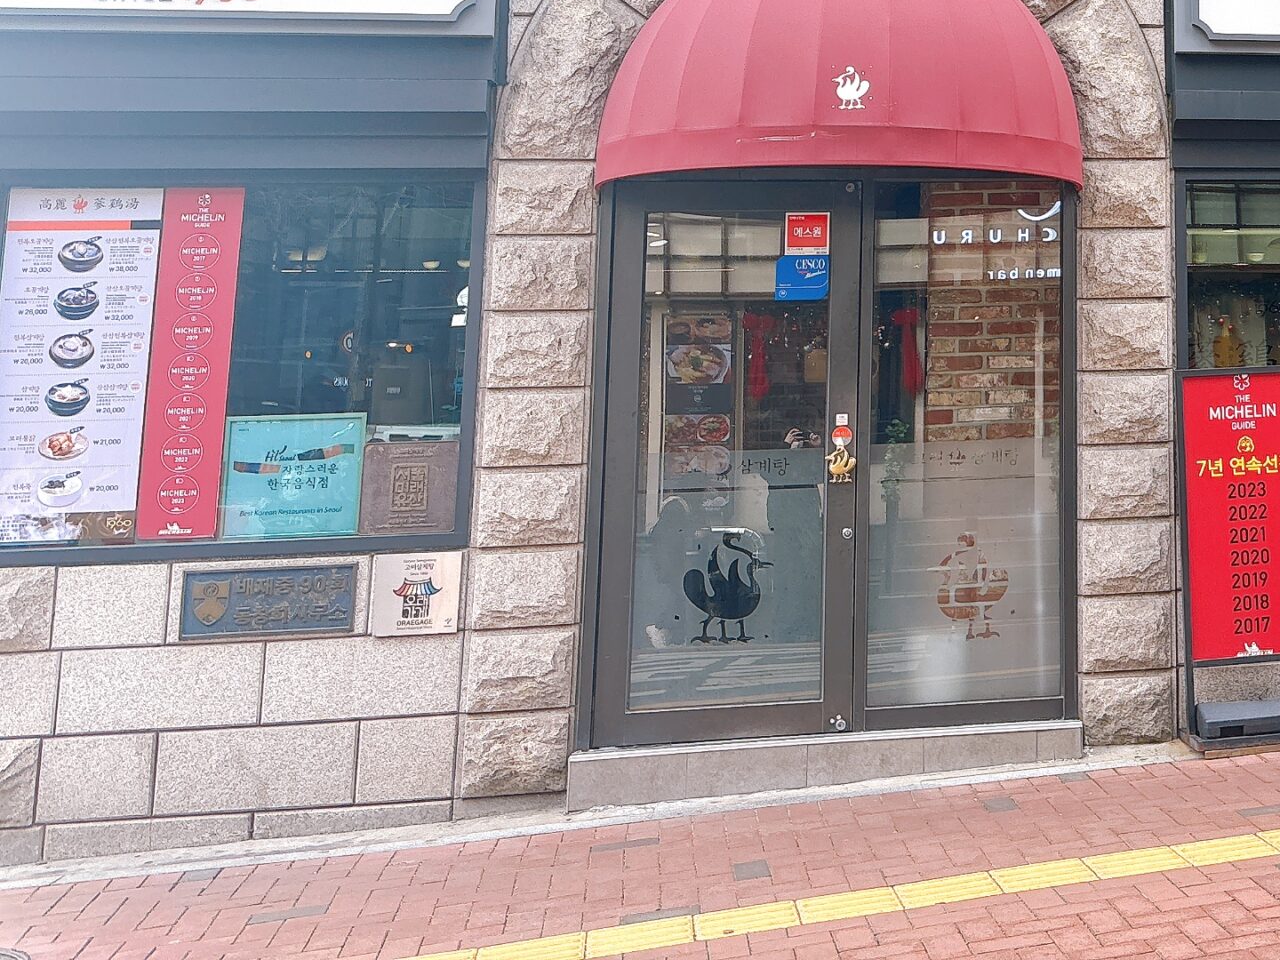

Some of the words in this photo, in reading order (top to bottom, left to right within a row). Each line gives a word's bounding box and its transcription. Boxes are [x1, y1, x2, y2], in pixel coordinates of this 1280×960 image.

[181, 213, 225, 222] MICHELIN
[793, 226, 822, 238] 에스원
[182, 247, 218, 255] MICHELIN
[795, 258, 826, 270] CESCO
[178, 286, 215, 295] MICHELIN
[174, 326, 211, 335] MICHELIN
[171, 366, 208, 375] MICHELIN
[1234, 394, 1250, 403] THE
[167, 407, 204, 416] MICHELIN
[1209, 403, 1277, 420] MICHELIN
[1231, 421, 1256, 431] GUIDE
[163, 448, 200, 456] MICHELIN
[281, 463, 339, 476] 자랑스러운
[737, 457, 790, 477] 삼계탕
[1196, 458, 1224, 477] 7년
[267, 476, 329, 491] 한국음식점
[395, 481, 424, 493] 미래
[160, 489, 197, 498] MICHELIN
[1228, 482, 1267, 499] 2023
[324, 506, 343, 514] Seoul
[1229, 504, 1268, 521] 2022
[1230, 526, 1266, 544] 2021
[1230, 548, 1270, 566] 2020
[1232, 571, 1268, 589] 2019
[1233, 594, 1269, 611] 2018
[1234, 616, 1270, 634] 2017
